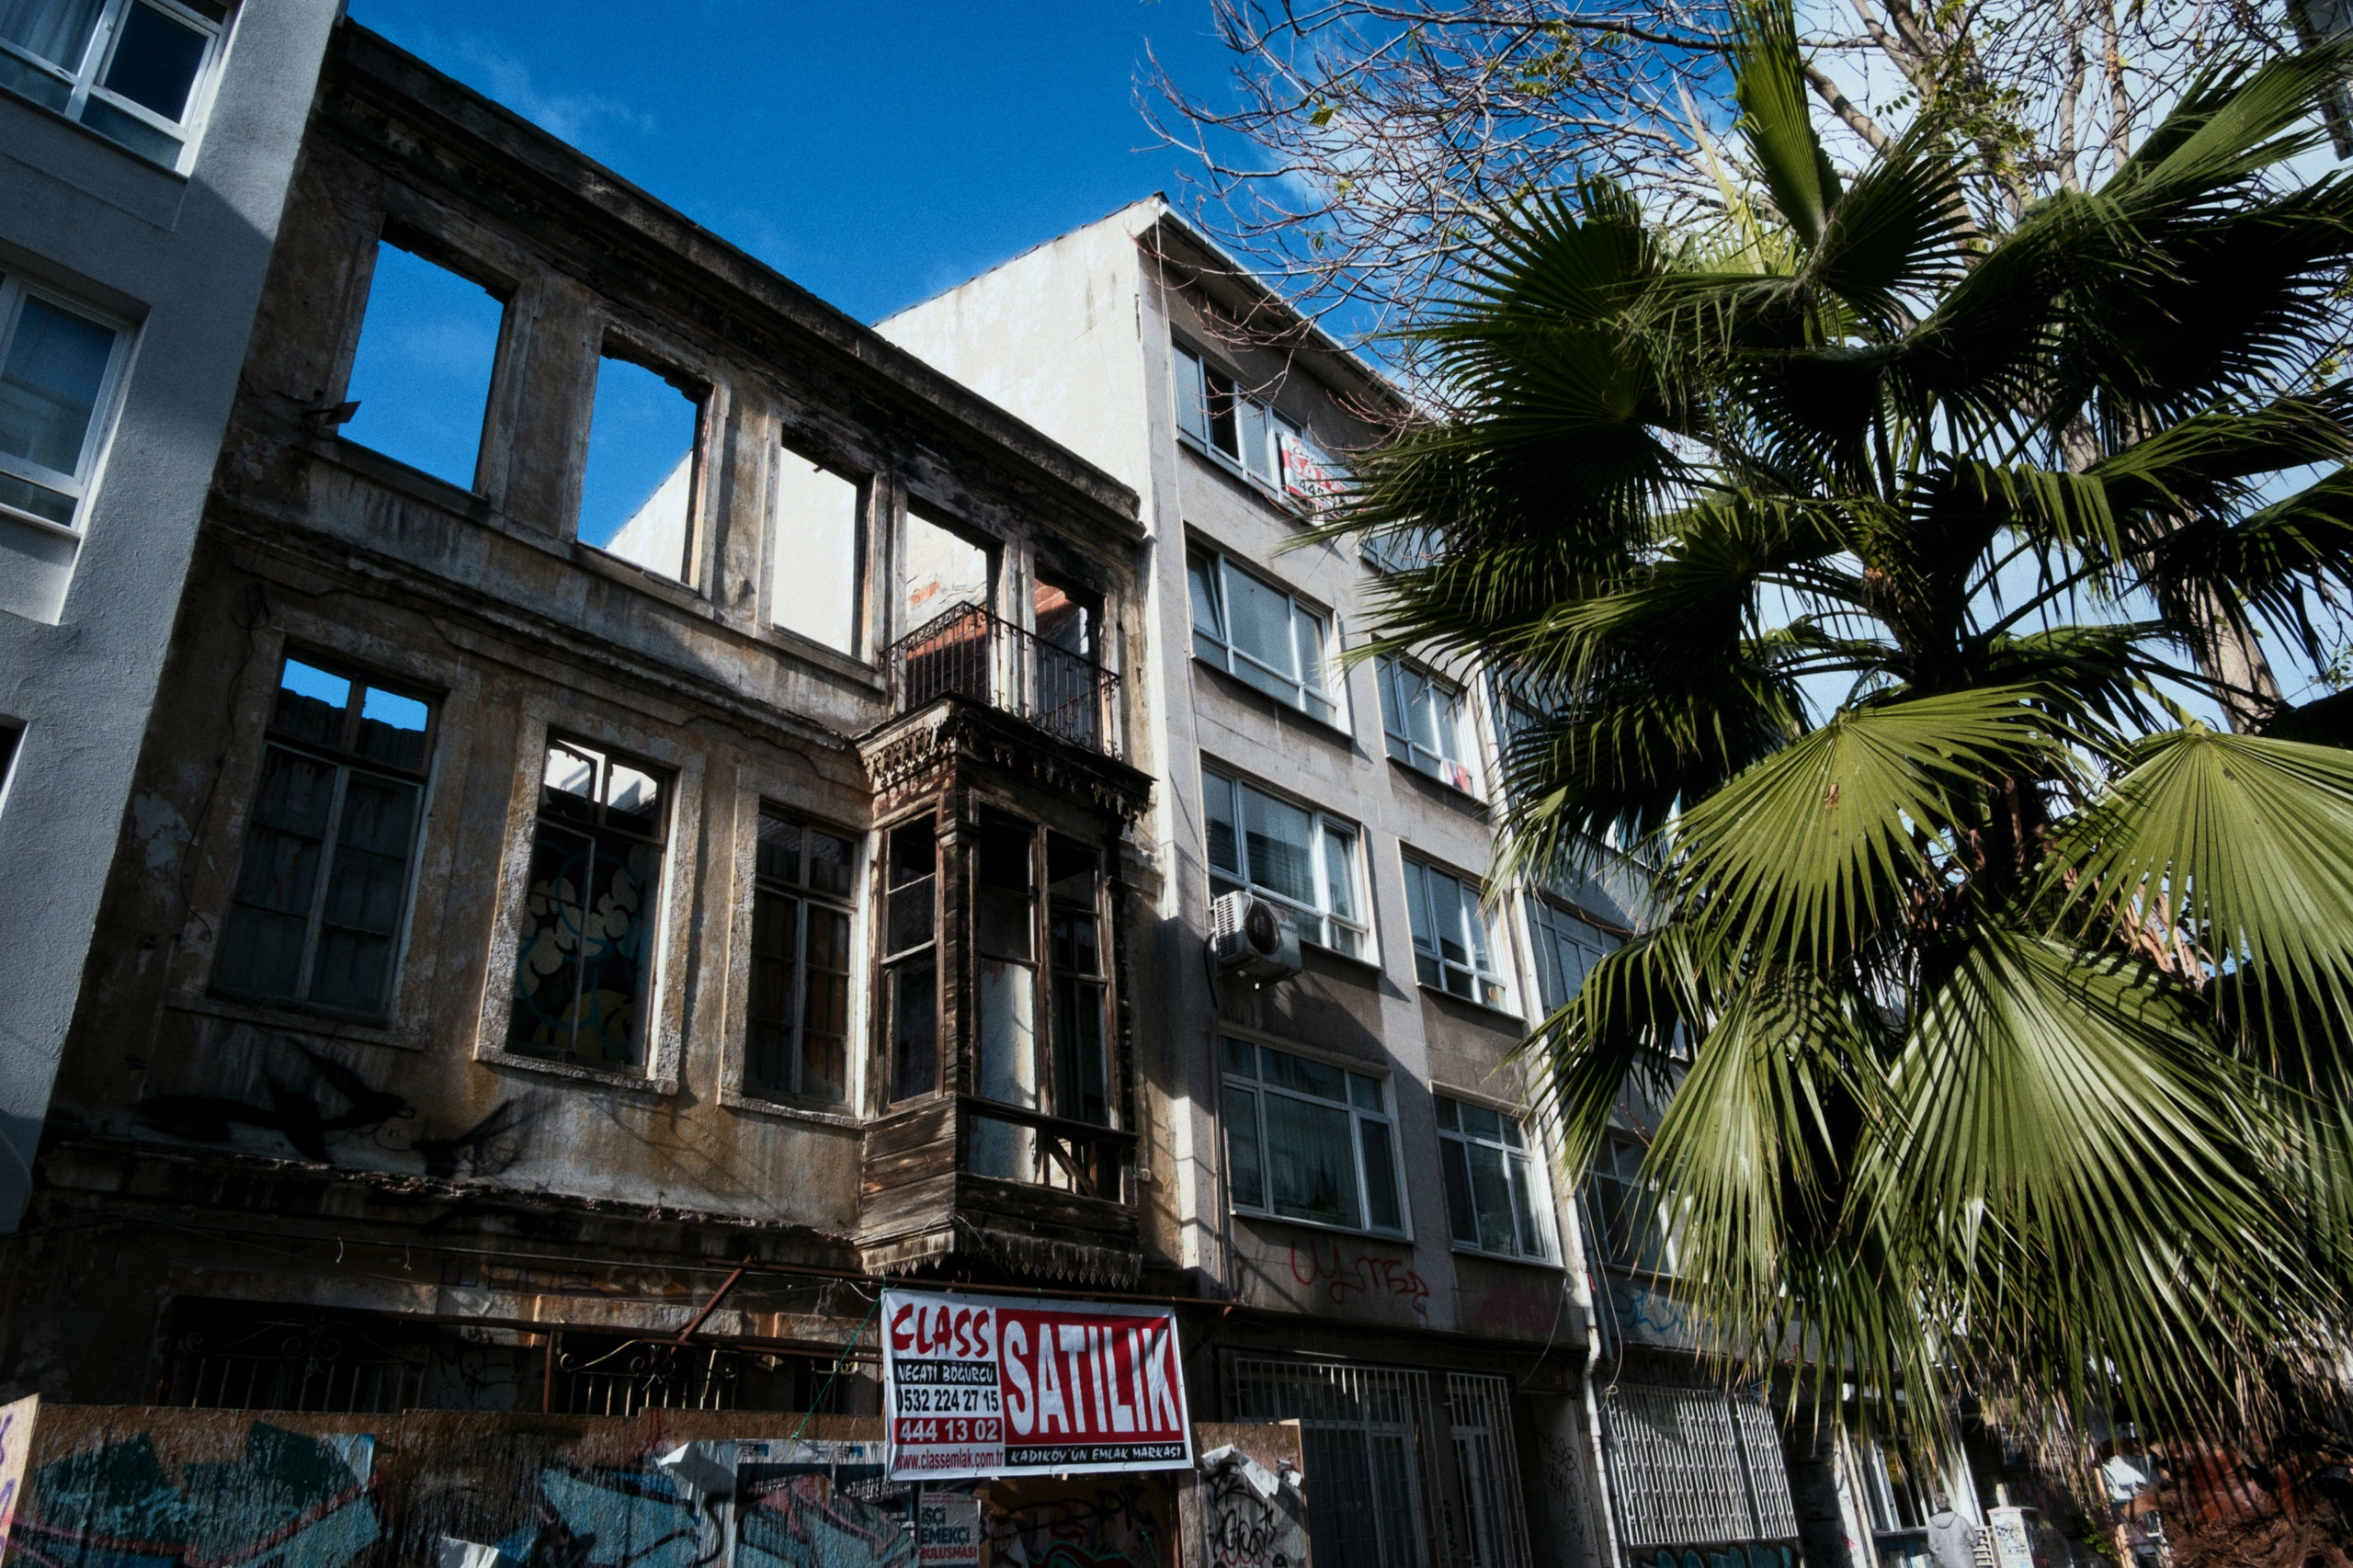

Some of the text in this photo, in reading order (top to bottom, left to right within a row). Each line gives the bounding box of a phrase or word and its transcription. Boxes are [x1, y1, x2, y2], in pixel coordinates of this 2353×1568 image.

[892, 1303, 990, 1358] CLASS
[897, 1361, 994, 1383] NECATİ BÖĞÜRCÜ
[1003, 1320, 1181, 1436] SATILIK
[1554, 1375, 1563, 1385] 22
[896, 1389, 999, 1413] 0532 224 27 15
[899, 1419, 998, 1442] 444 13 02
[895, 1448, 1004, 1471] www.classemlak.com.tr
[1010, 1446, 1181, 1463] KADIKÖY'ÜN EMLAK MARKASI
[921, 1506, 947, 1527] İŞÇİ
[920, 1527, 971, 1545] EMEKÇİ
[920, 1546, 978, 1561] BULUŞMASI
